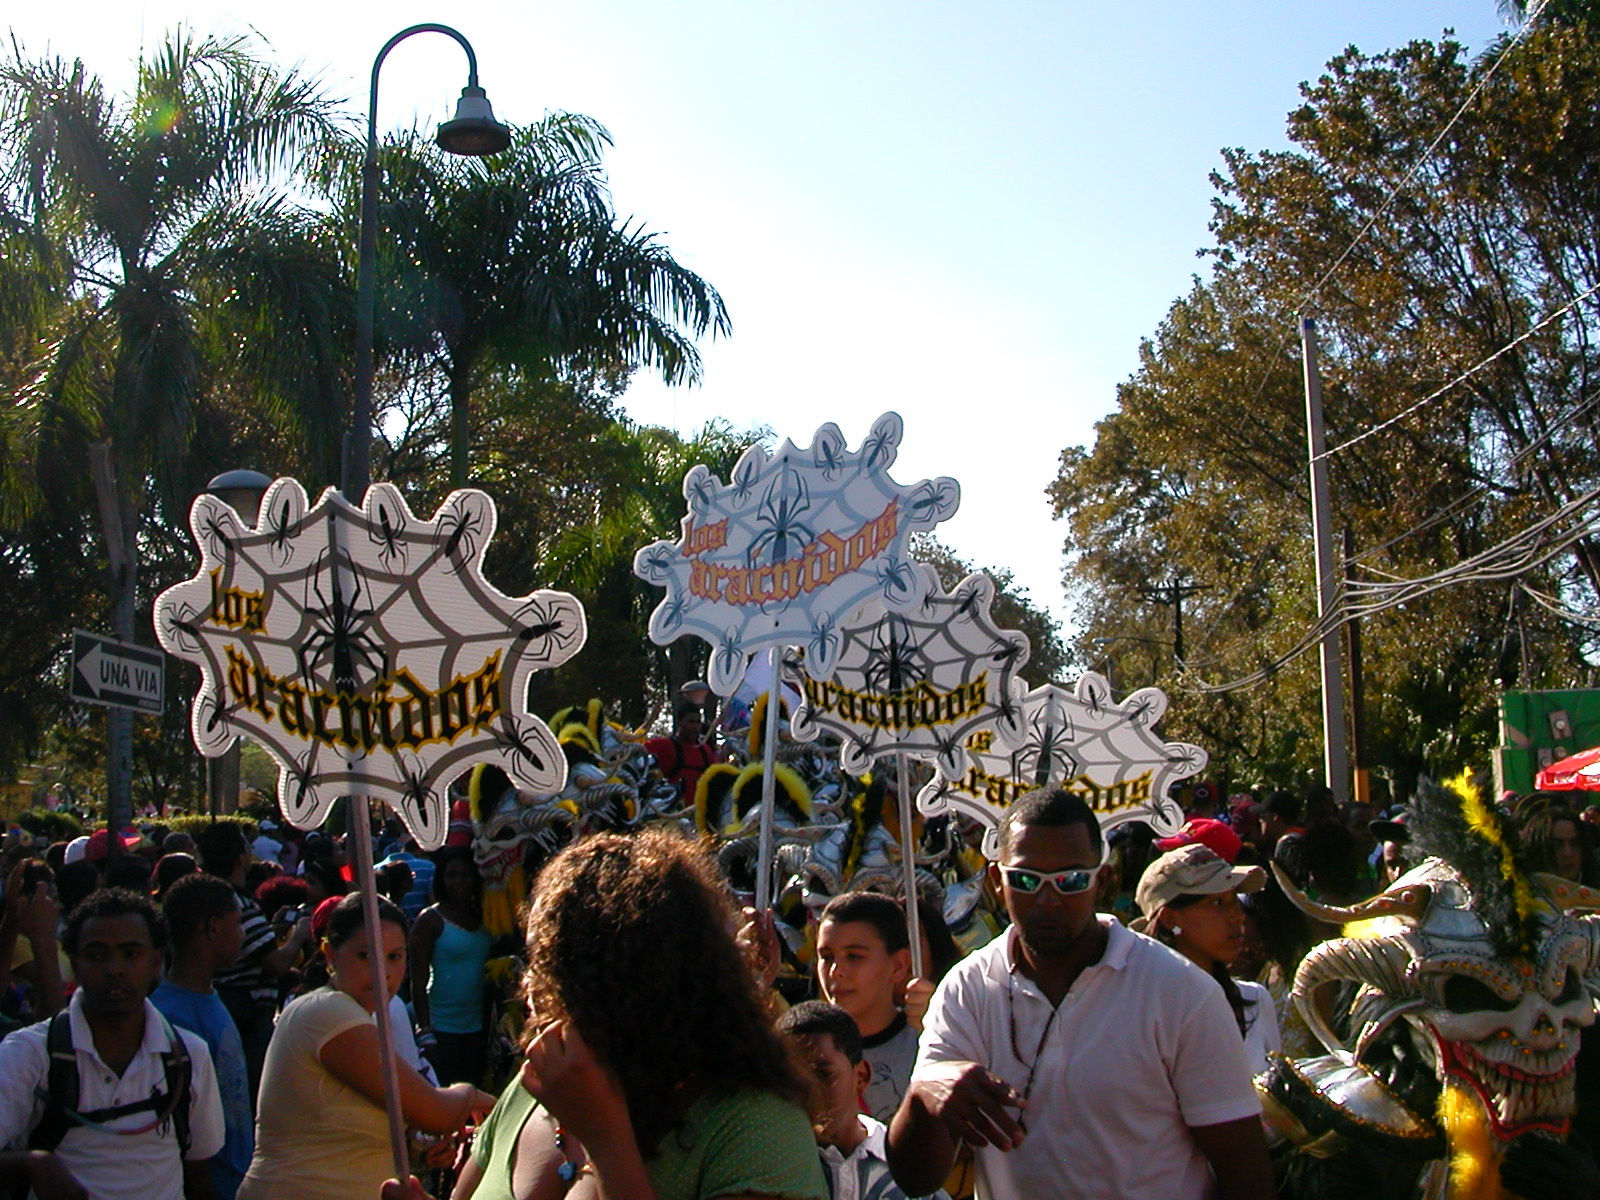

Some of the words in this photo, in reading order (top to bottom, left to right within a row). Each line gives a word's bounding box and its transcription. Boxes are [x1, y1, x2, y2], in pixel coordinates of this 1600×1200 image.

[681, 515, 729, 558] los
[209, 565, 269, 636] los
[101, 660, 130, 689] UNA
[135, 667, 158, 694] VIA
